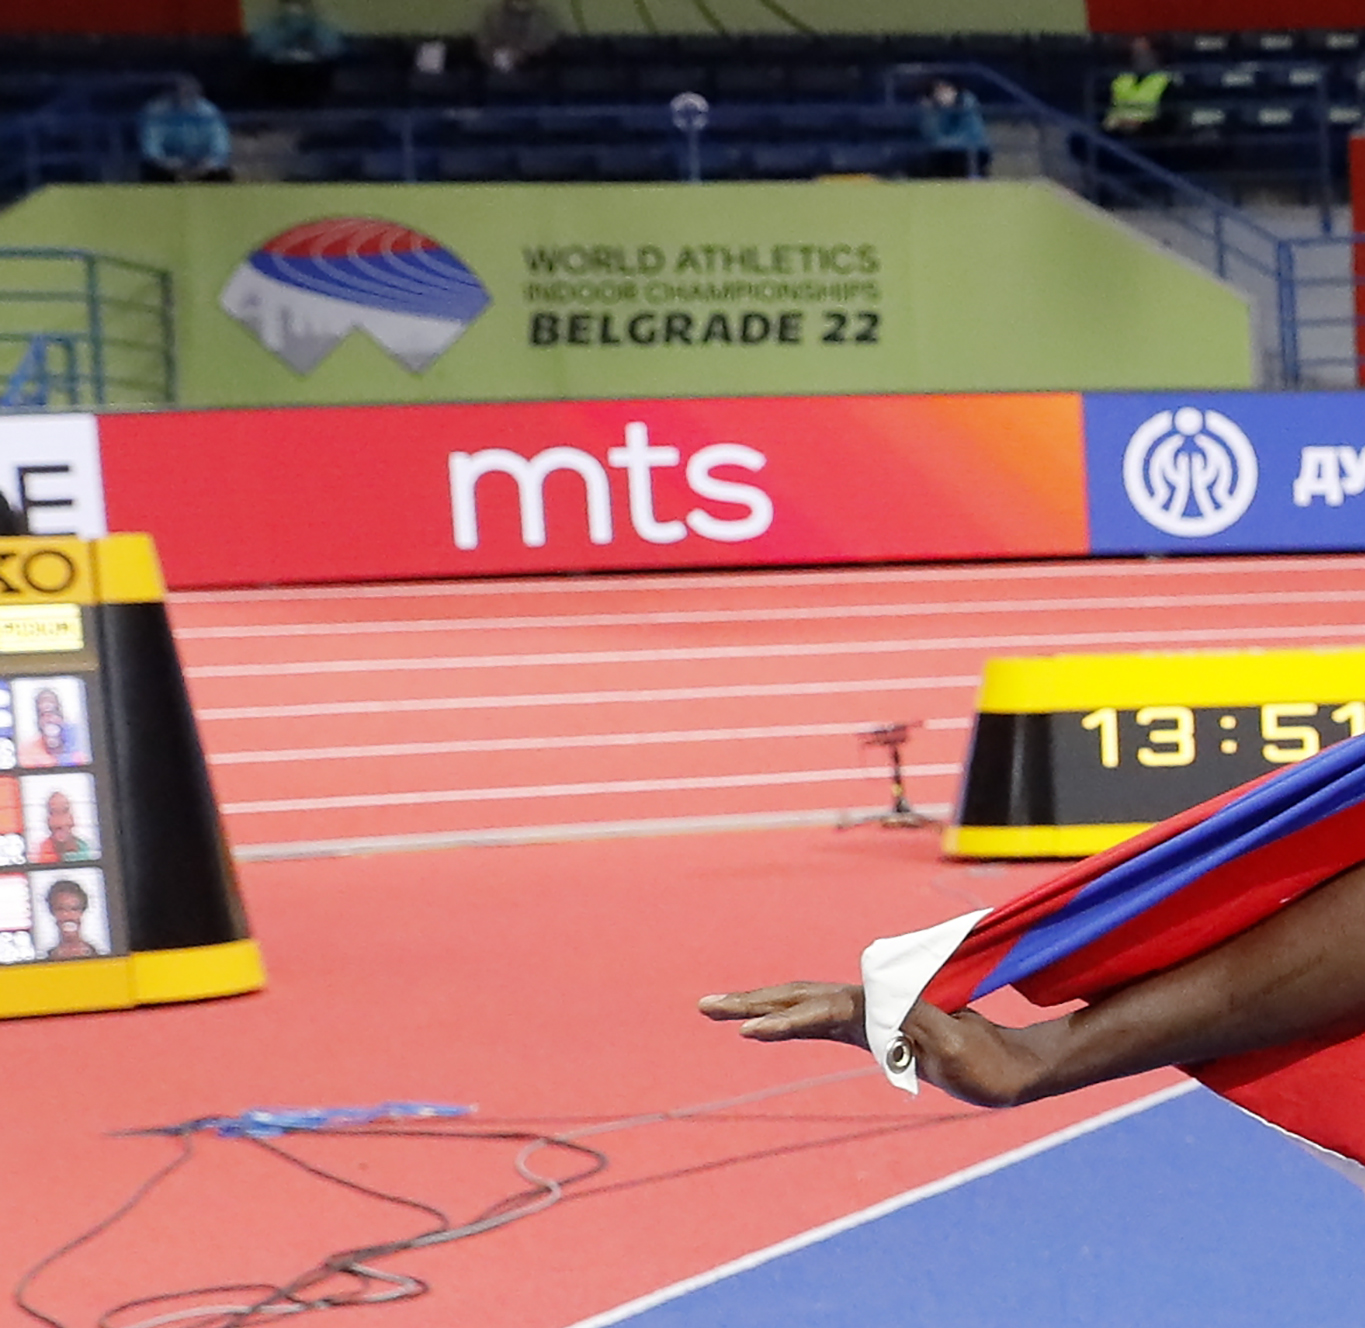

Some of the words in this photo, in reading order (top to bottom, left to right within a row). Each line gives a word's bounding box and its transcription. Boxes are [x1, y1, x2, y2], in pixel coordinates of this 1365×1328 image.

[526, 245, 667, 275] WORLD
[674, 245, 881, 275] ATHLETICS
[527, 280, 638, 302] INDOOR
[648, 279, 882, 302] CHAMPIONSHIPS
[529, 311, 803, 347] BELGRADE
[822, 311, 882, 346] 22
[448, 420, 774, 550] mts
